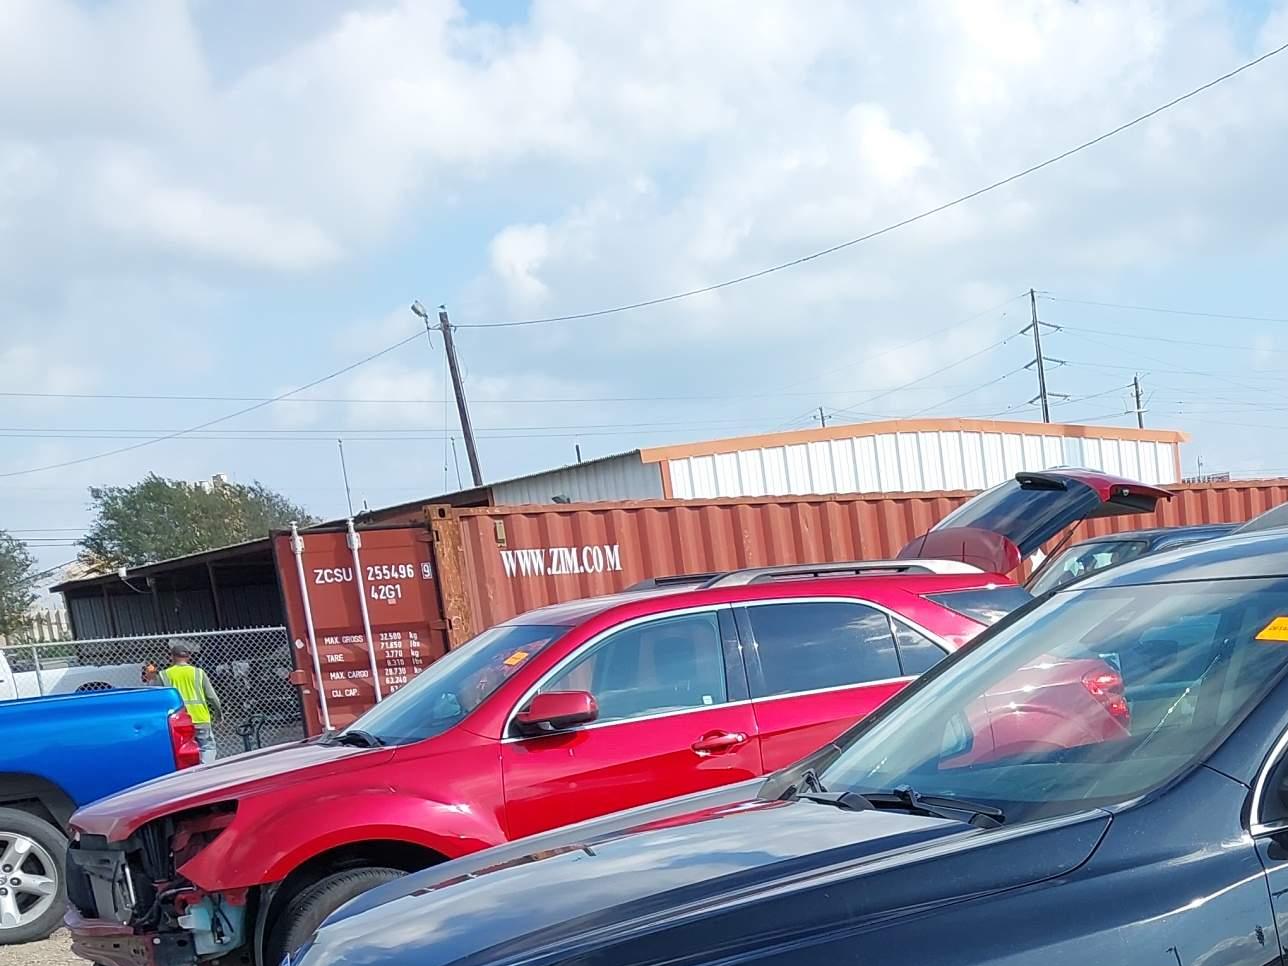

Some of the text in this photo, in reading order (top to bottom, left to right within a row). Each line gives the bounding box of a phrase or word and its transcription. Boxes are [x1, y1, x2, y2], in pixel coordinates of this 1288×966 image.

[314, 563, 431, 584] ZCSU 255496 9
[371, 584, 402, 600] 42G1
[342, 635, 364, 644] GROSS
[409, 631, 418, 641] kg
[326, 654, 345, 663] TARE
[347, 670, 369, 679] CARGO
